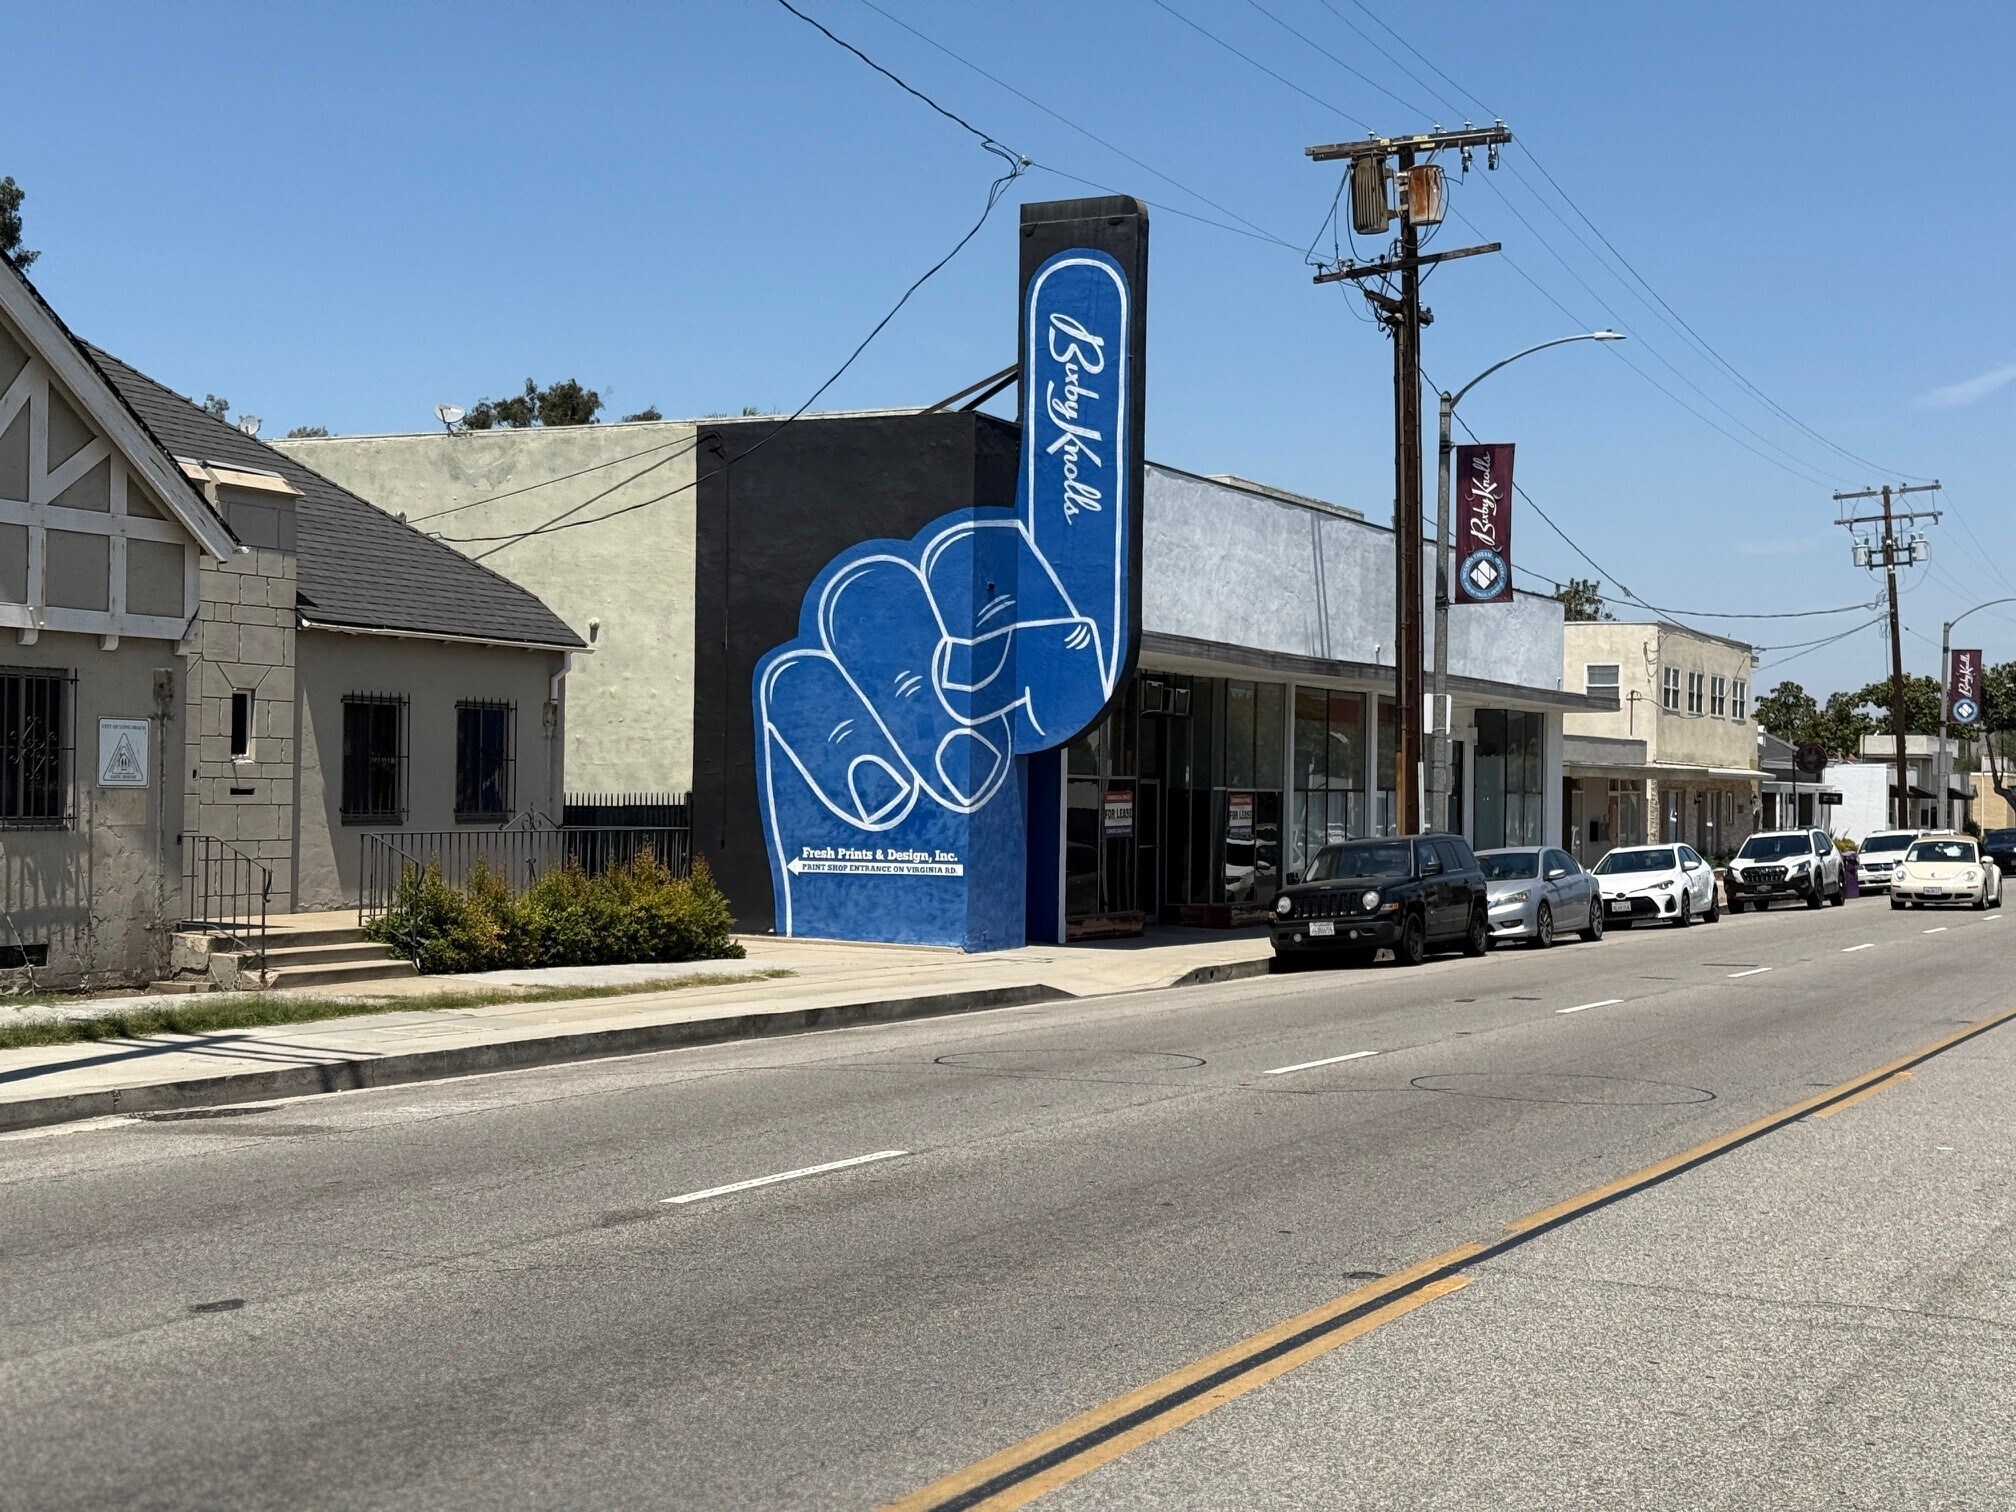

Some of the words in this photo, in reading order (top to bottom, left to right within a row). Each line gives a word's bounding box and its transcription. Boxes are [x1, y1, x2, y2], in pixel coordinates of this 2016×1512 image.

[1046, 380, 1103, 526] Knolls
[1106, 809, 1116, 819] FOR
[1117, 808, 1133, 819] LEASE
[1230, 811, 1238, 820] FOR
[1238, 810, 1253, 819] LEASE
[802, 846, 835, 859] Fresh
[838, 848, 873, 860] Prints
[876, 848, 885, 860] &
[887, 848, 933, 863] Design,
[935, 850, 958, 862] Inc.
[828, 864, 848, 872] SHOP
[849, 864, 892, 873] ENTRANCE
[906, 866, 943, 874] VIRGINIA
